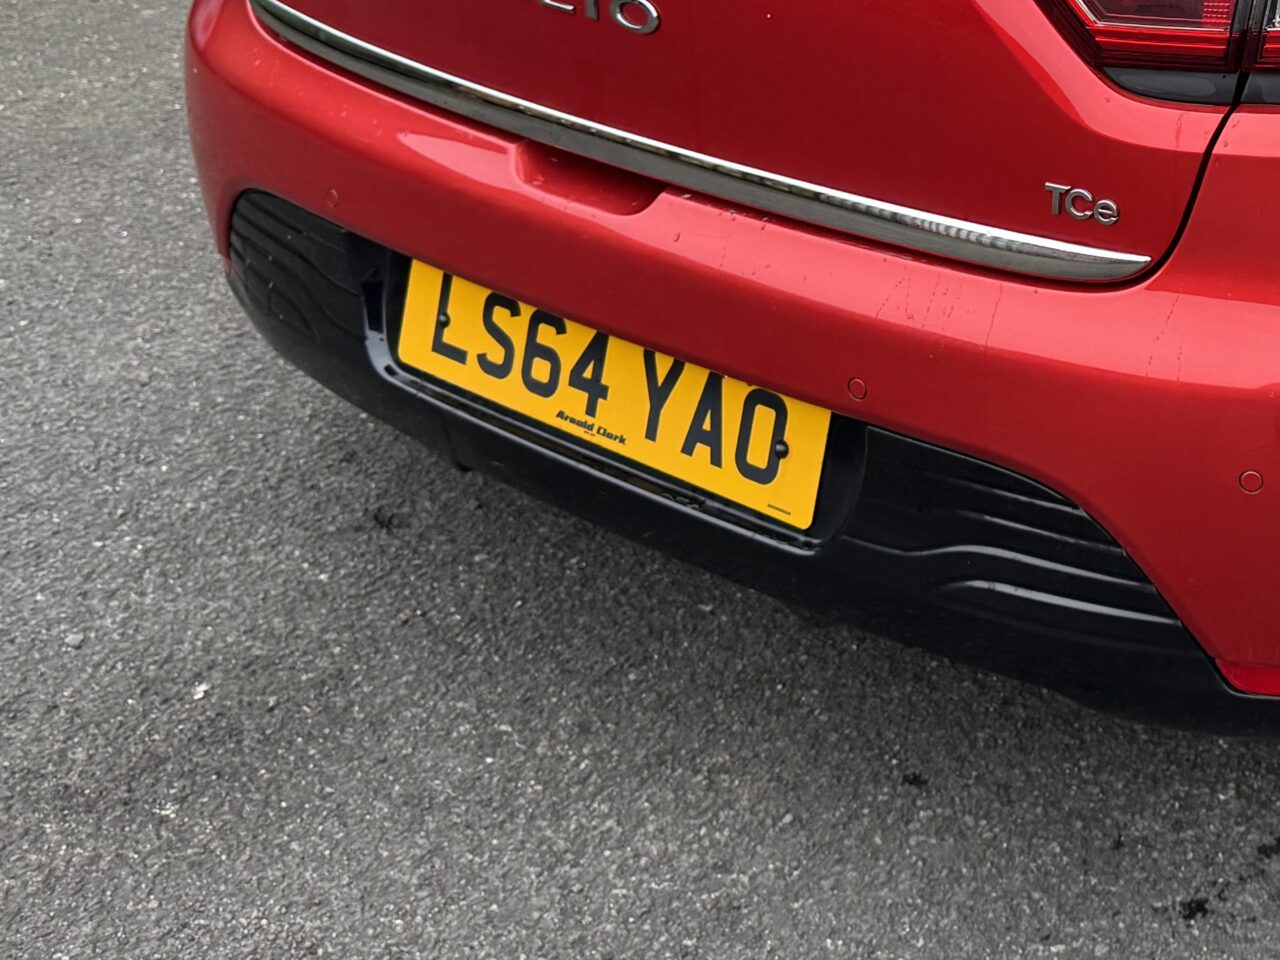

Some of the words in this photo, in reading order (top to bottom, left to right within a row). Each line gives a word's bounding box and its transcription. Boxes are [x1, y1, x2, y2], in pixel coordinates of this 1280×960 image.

[1043, 181, 1119, 226] TCe
[431, 272, 610, 418] LS64
[643, 347, 788, 486] YAO
